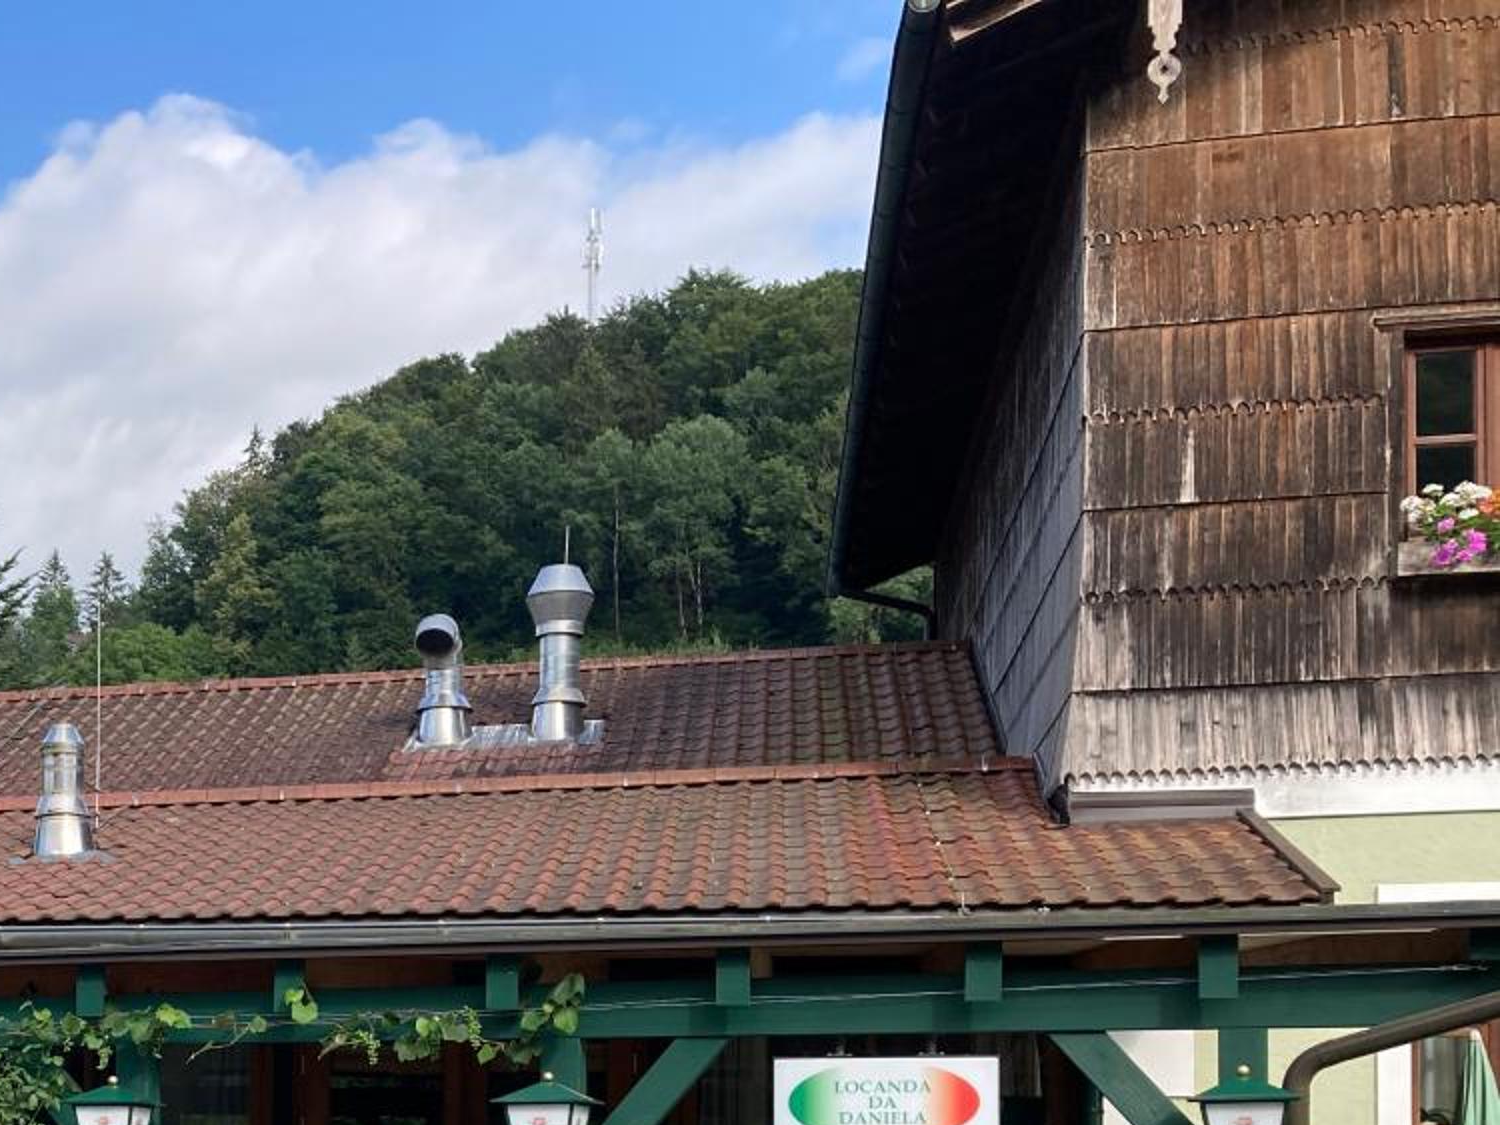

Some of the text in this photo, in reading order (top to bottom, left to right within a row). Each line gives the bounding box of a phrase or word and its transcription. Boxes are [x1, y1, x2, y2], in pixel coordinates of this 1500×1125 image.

[835, 1079, 931, 1095] LOCANDA
[868, 1095, 897, 1109] DA
[839, 1111, 927, 1125] DANIELA
